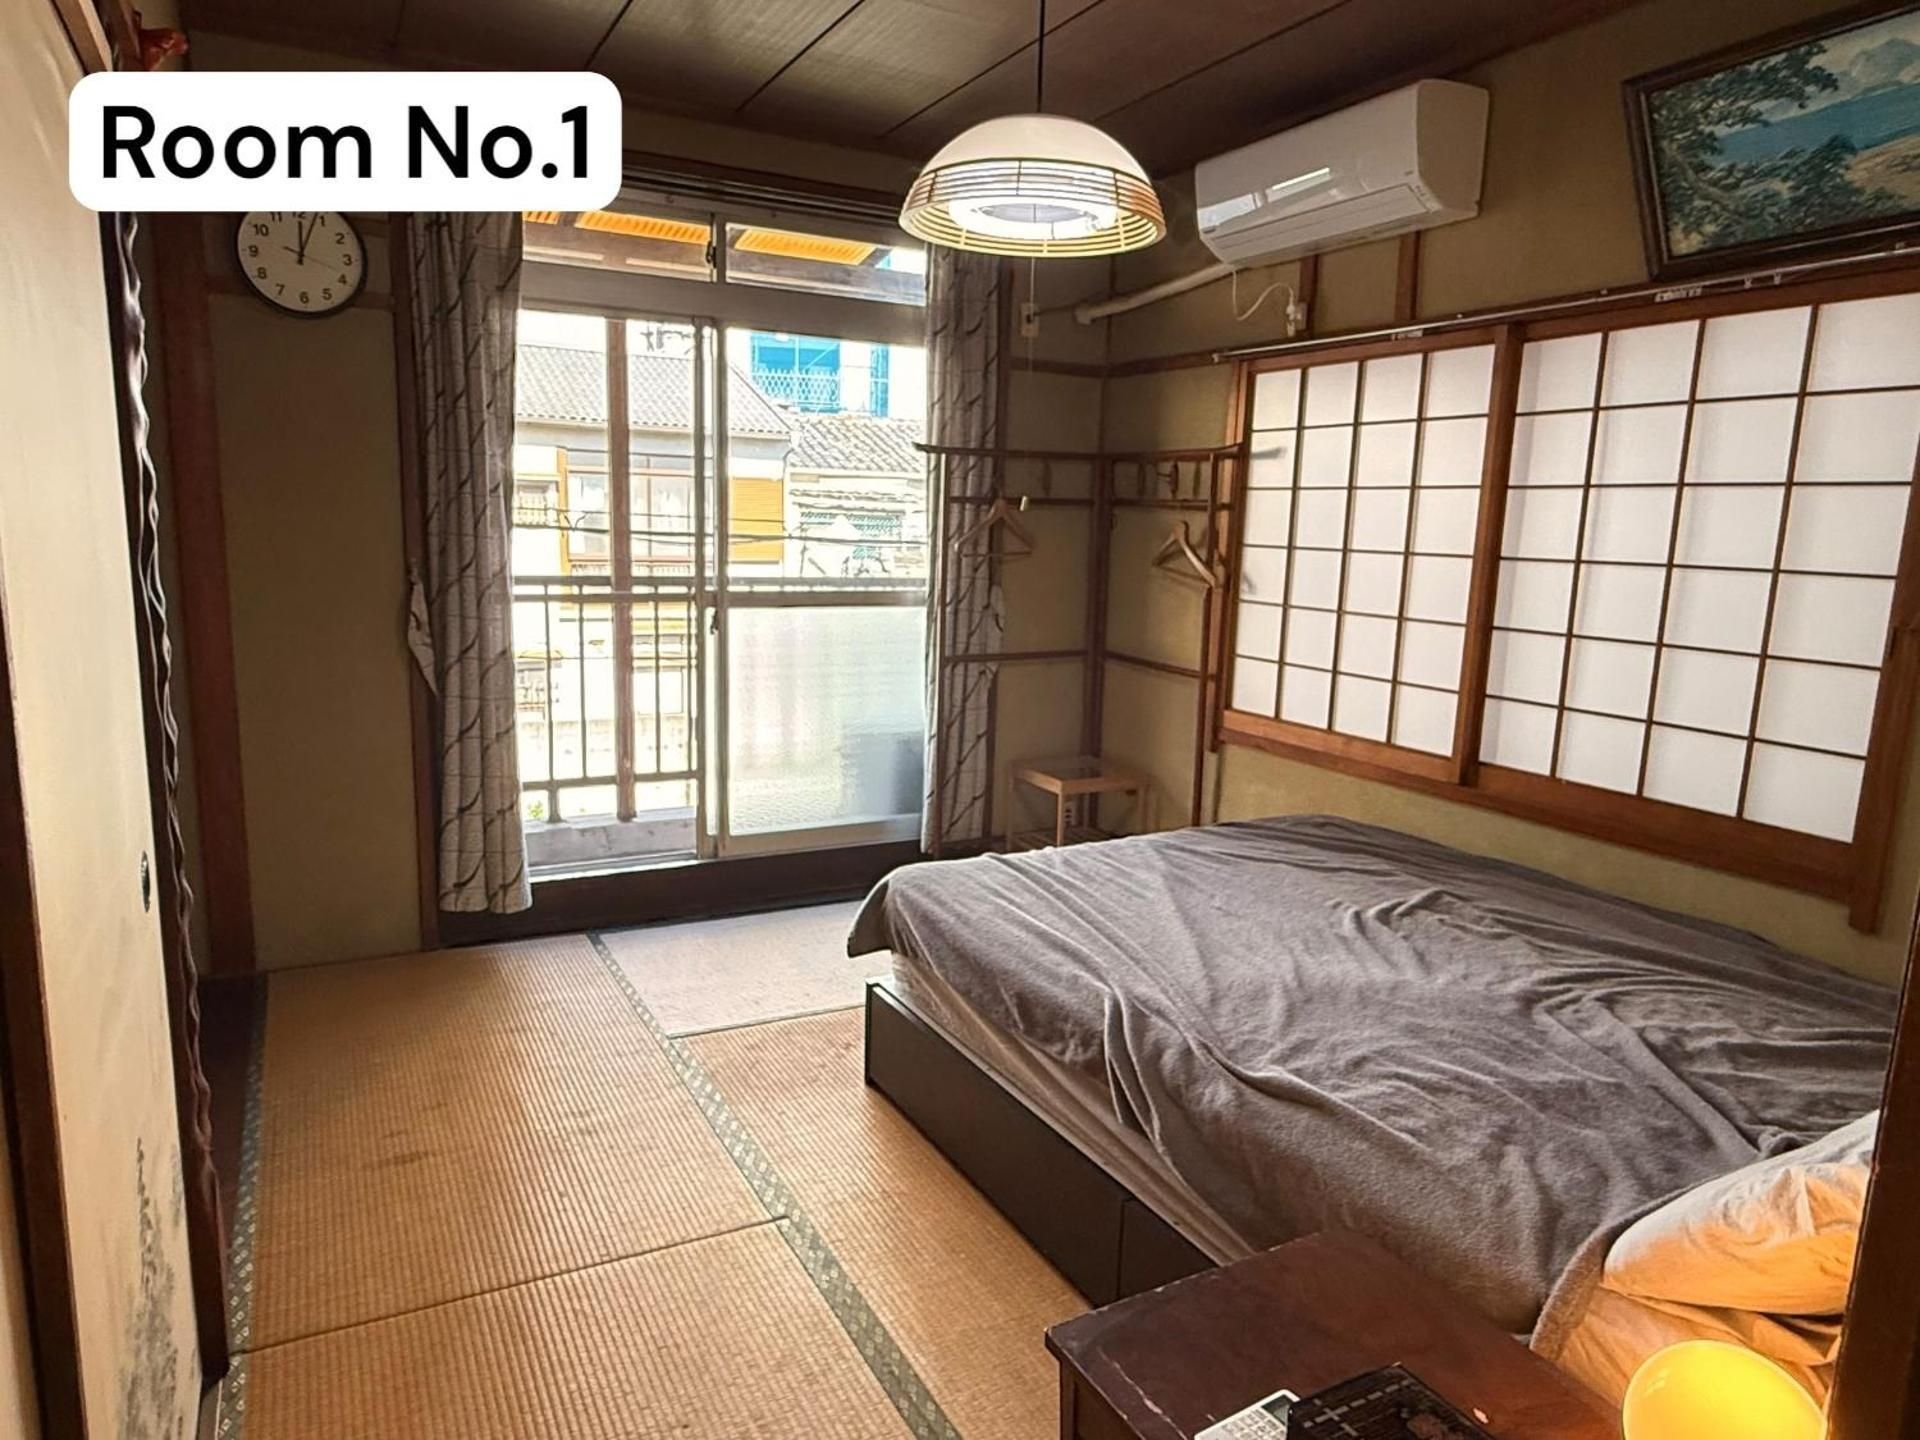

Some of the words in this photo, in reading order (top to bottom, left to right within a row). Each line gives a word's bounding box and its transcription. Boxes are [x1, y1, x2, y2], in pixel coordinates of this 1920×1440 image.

[270, 211, 282, 222] 11
[319, 215, 325, 227] 1
[253, 224, 269, 237] 10
[335, 232, 345, 245] 2
[248, 245, 259, 257] 9
[342, 254, 353, 266] 3
[256, 267, 267, 280] 8
[337, 274, 347, 285] 4
[275, 283, 285, 296] 7
[322, 288, 332, 300] 5
[299, 291, 310, 304] 6
